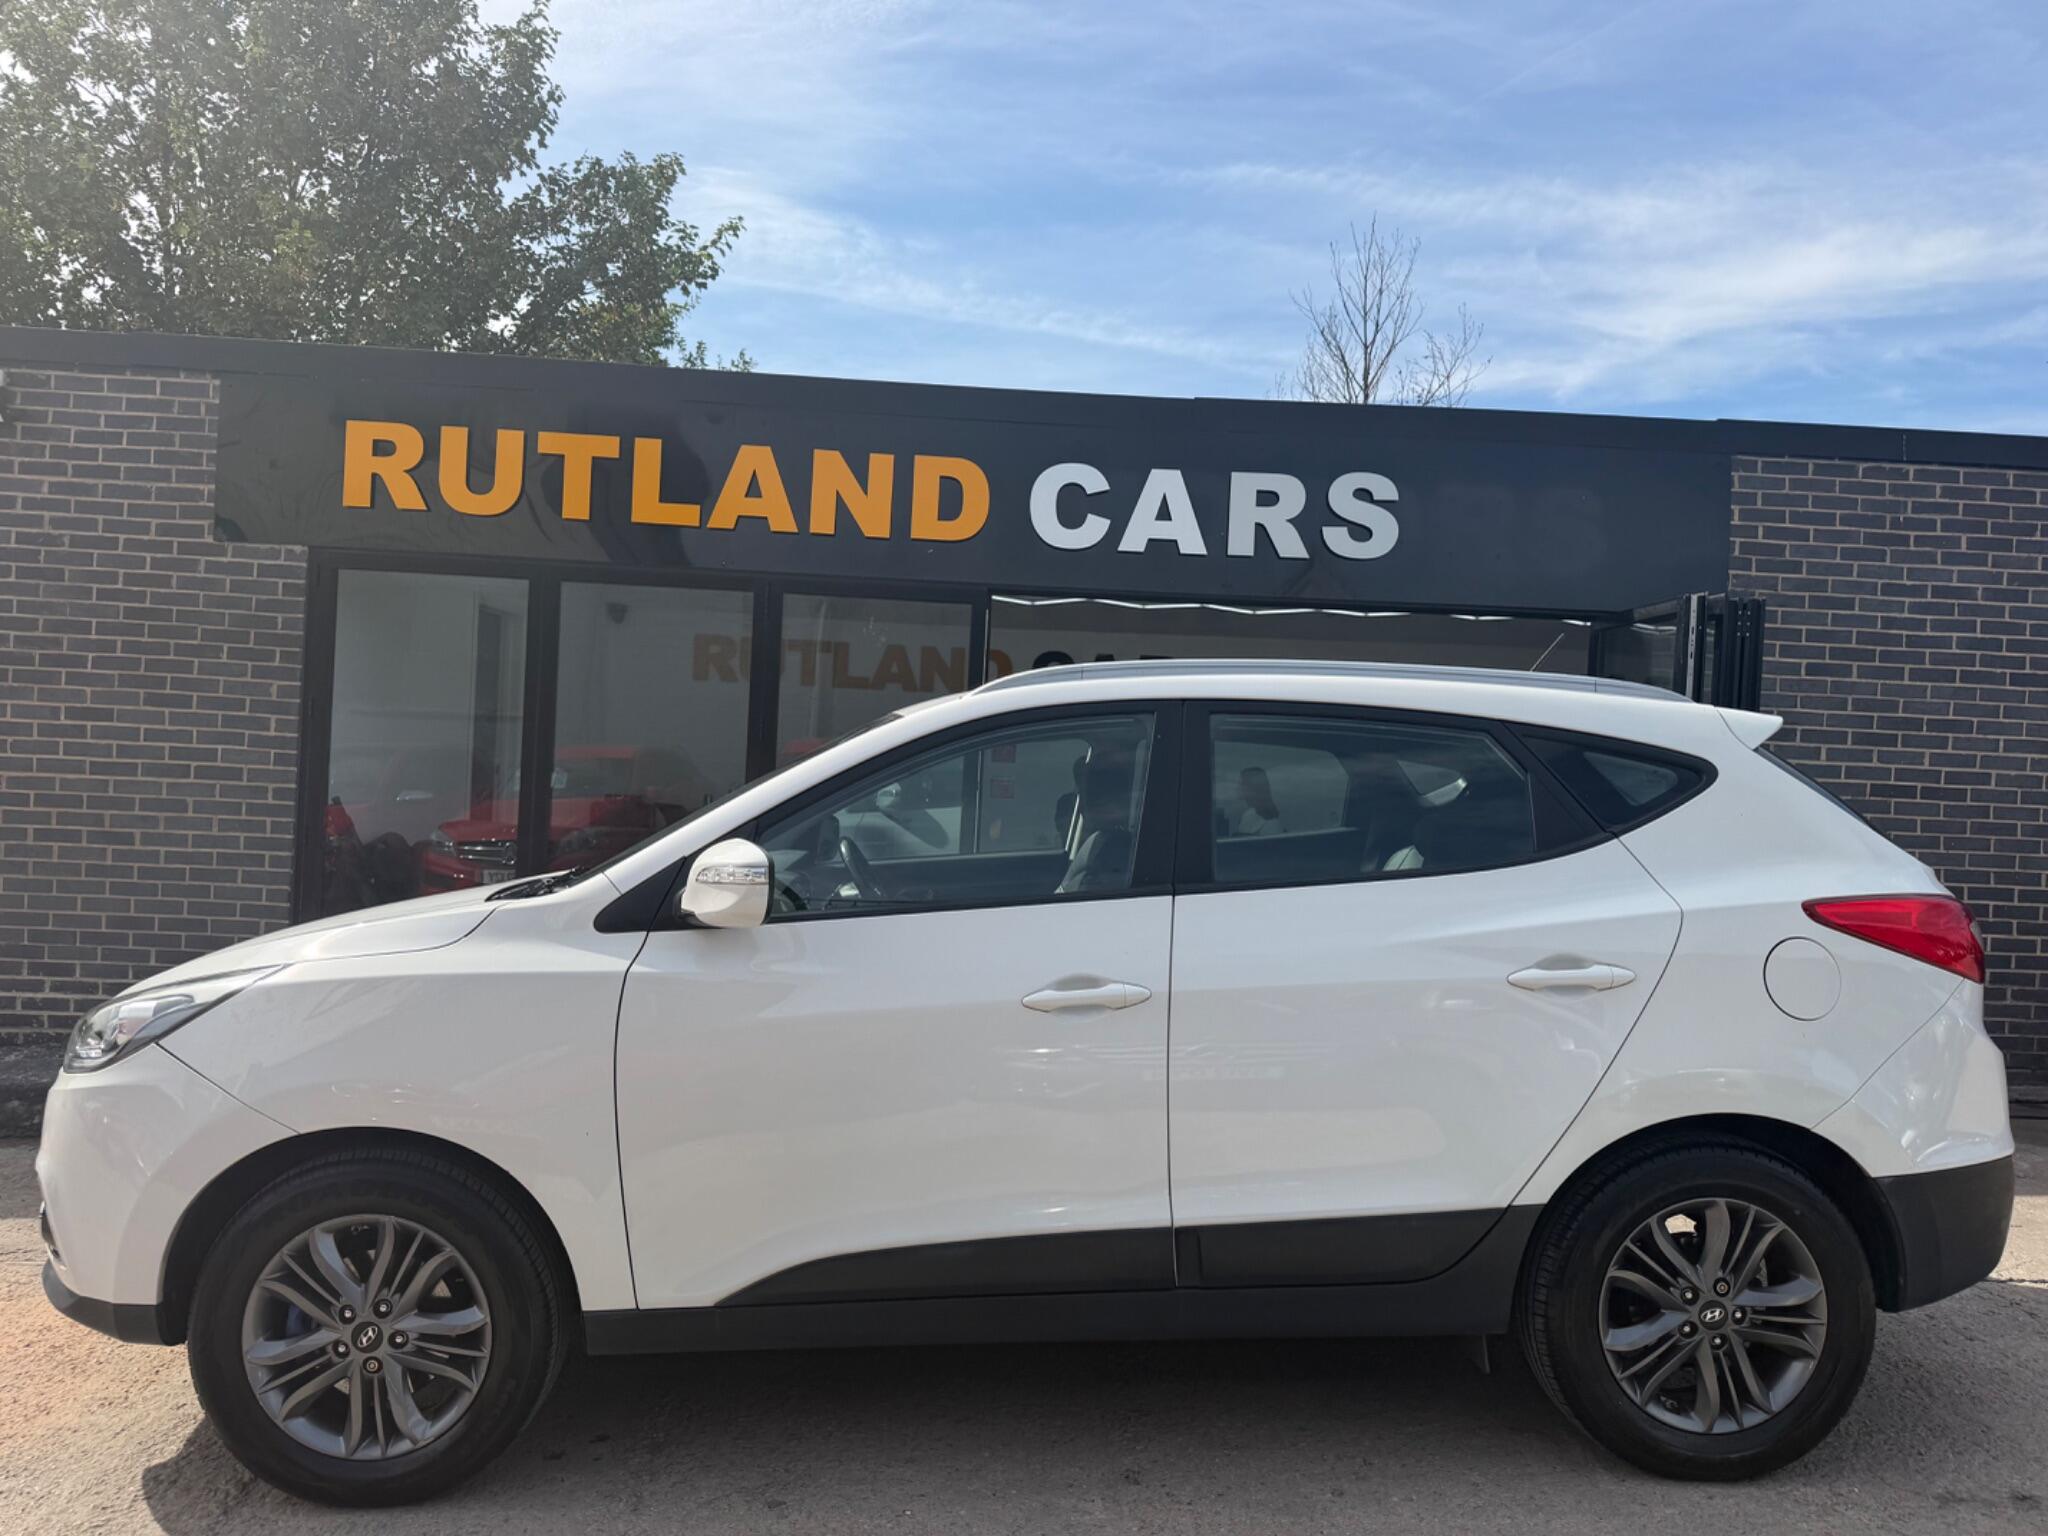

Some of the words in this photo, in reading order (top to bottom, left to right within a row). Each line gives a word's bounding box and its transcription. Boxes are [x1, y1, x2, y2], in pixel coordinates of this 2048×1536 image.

[342, 420, 990, 541] RUTLAND
[1029, 462, 1400, 560] CARS
[692, 633, 1014, 693] RTLAN
